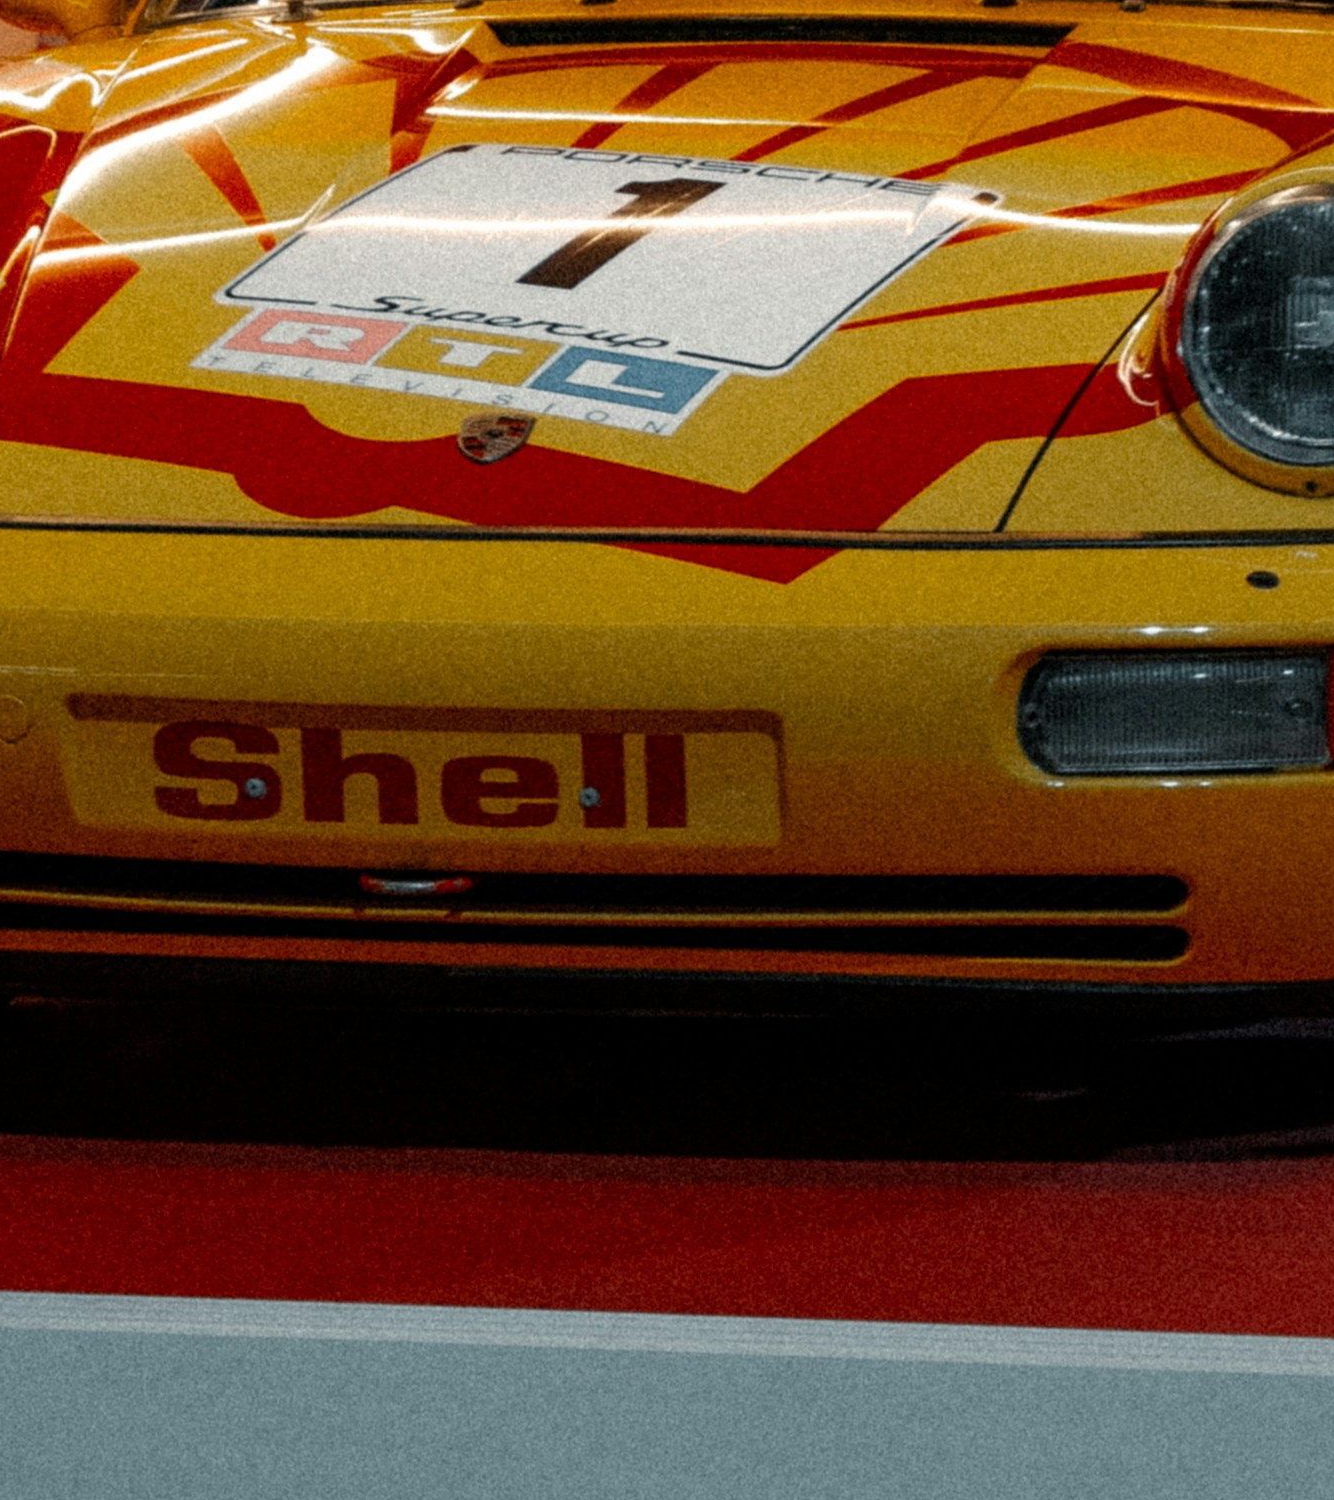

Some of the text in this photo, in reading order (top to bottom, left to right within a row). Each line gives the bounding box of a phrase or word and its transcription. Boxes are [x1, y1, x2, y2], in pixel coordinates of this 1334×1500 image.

[500, 145, 947, 197] PORSCHE
[515, 178, 729, 290] 1
[259, 319, 665, 400] RTL
[331, 295, 671, 349] Supercup
[207, 354, 668, 435] TELEVISION
[153, 720, 688, 829] Shell
